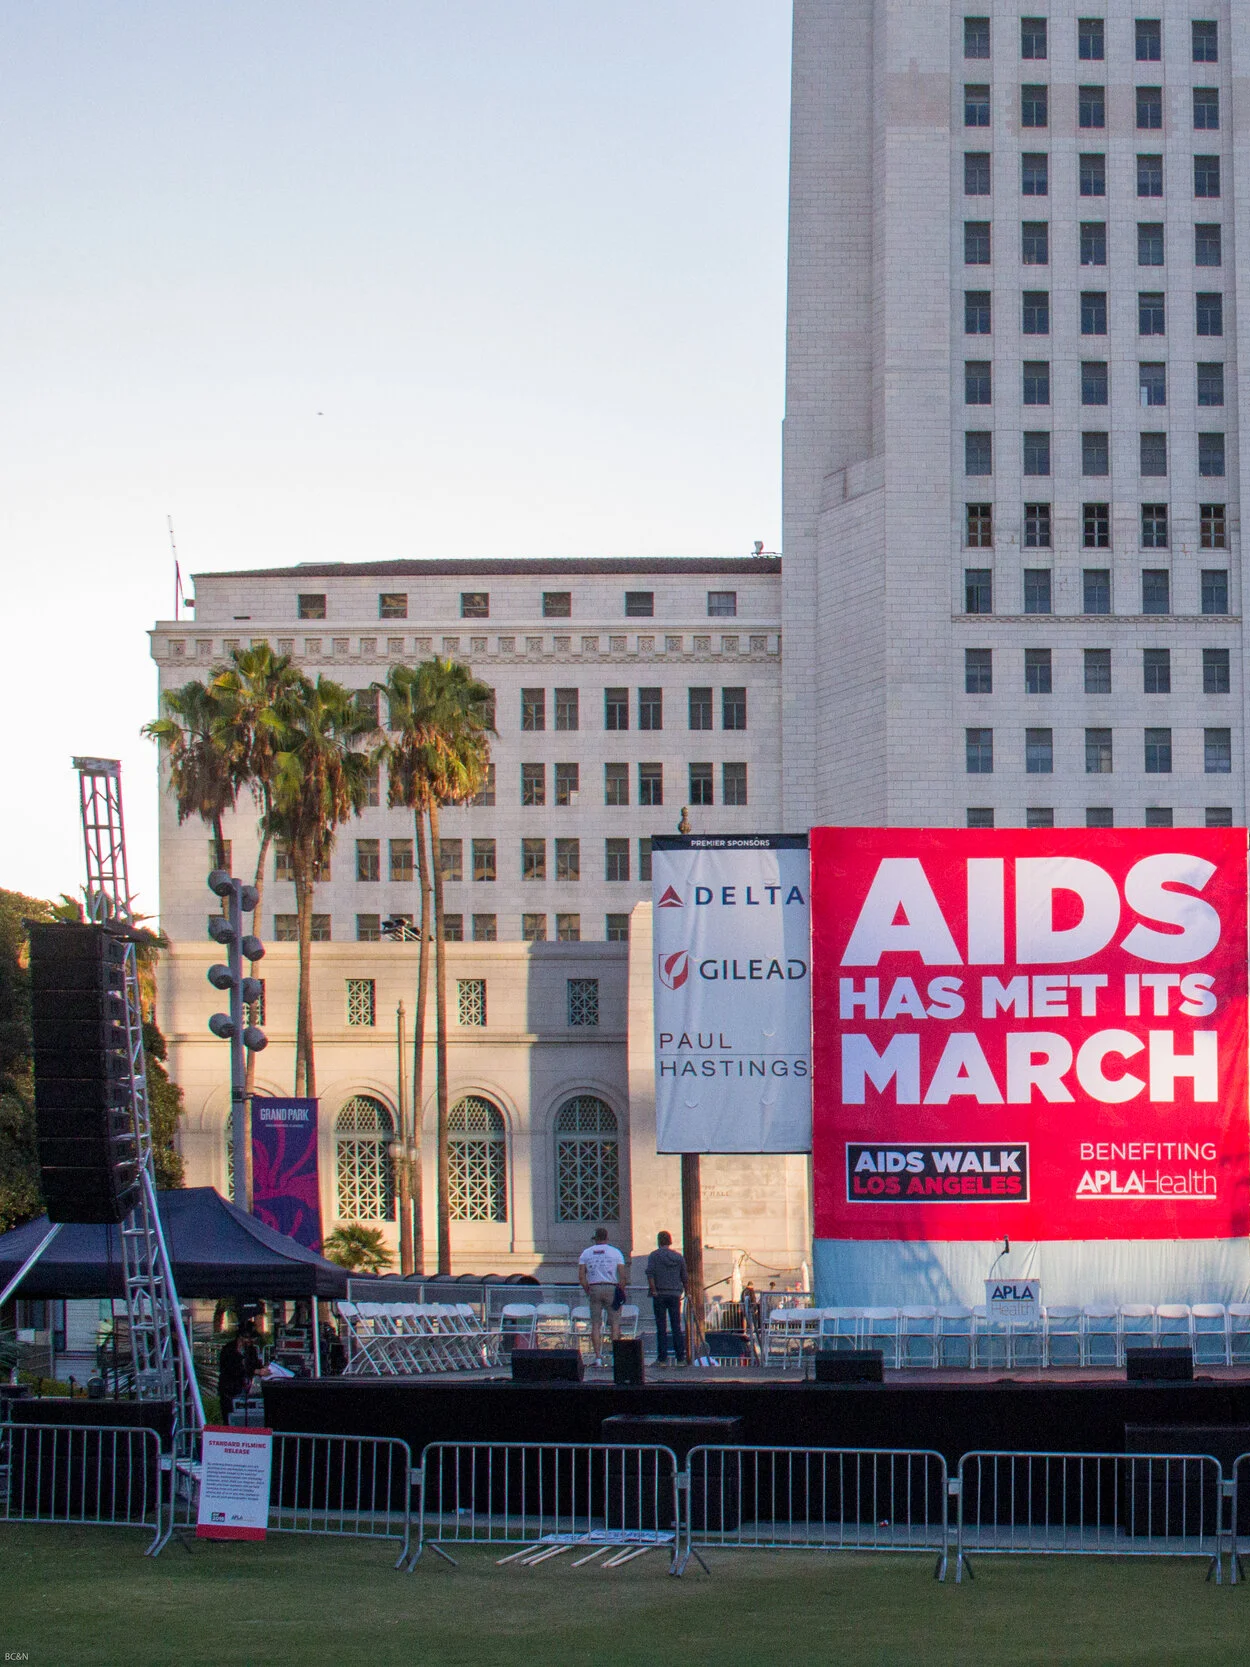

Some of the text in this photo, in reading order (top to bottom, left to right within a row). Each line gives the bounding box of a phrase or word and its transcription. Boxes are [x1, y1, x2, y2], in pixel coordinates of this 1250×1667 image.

[690, 838, 771, 847] PREMIER SPONSORS
[694, 885, 806, 906] DELTA
[840, 853, 1221, 966] AIDS
[699, 958, 807, 980] GILEAD
[839, 973, 1218, 1020] HAS MET ITS
[659, 1032, 733, 1049] PAUL
[659, 1060, 808, 1077] HASTINGS
[841, 1028, 1218, 1105] MARCH
[260, 1108, 310, 1121] GRAND PARK
[1080, 1142, 1217, 1161] BENEFITING
[853, 1151, 1022, 1173] AIDS WALK
[852, 1176, 1023, 1195] LOS ANGELES
[991, 1284, 1035, 1300] APLA
